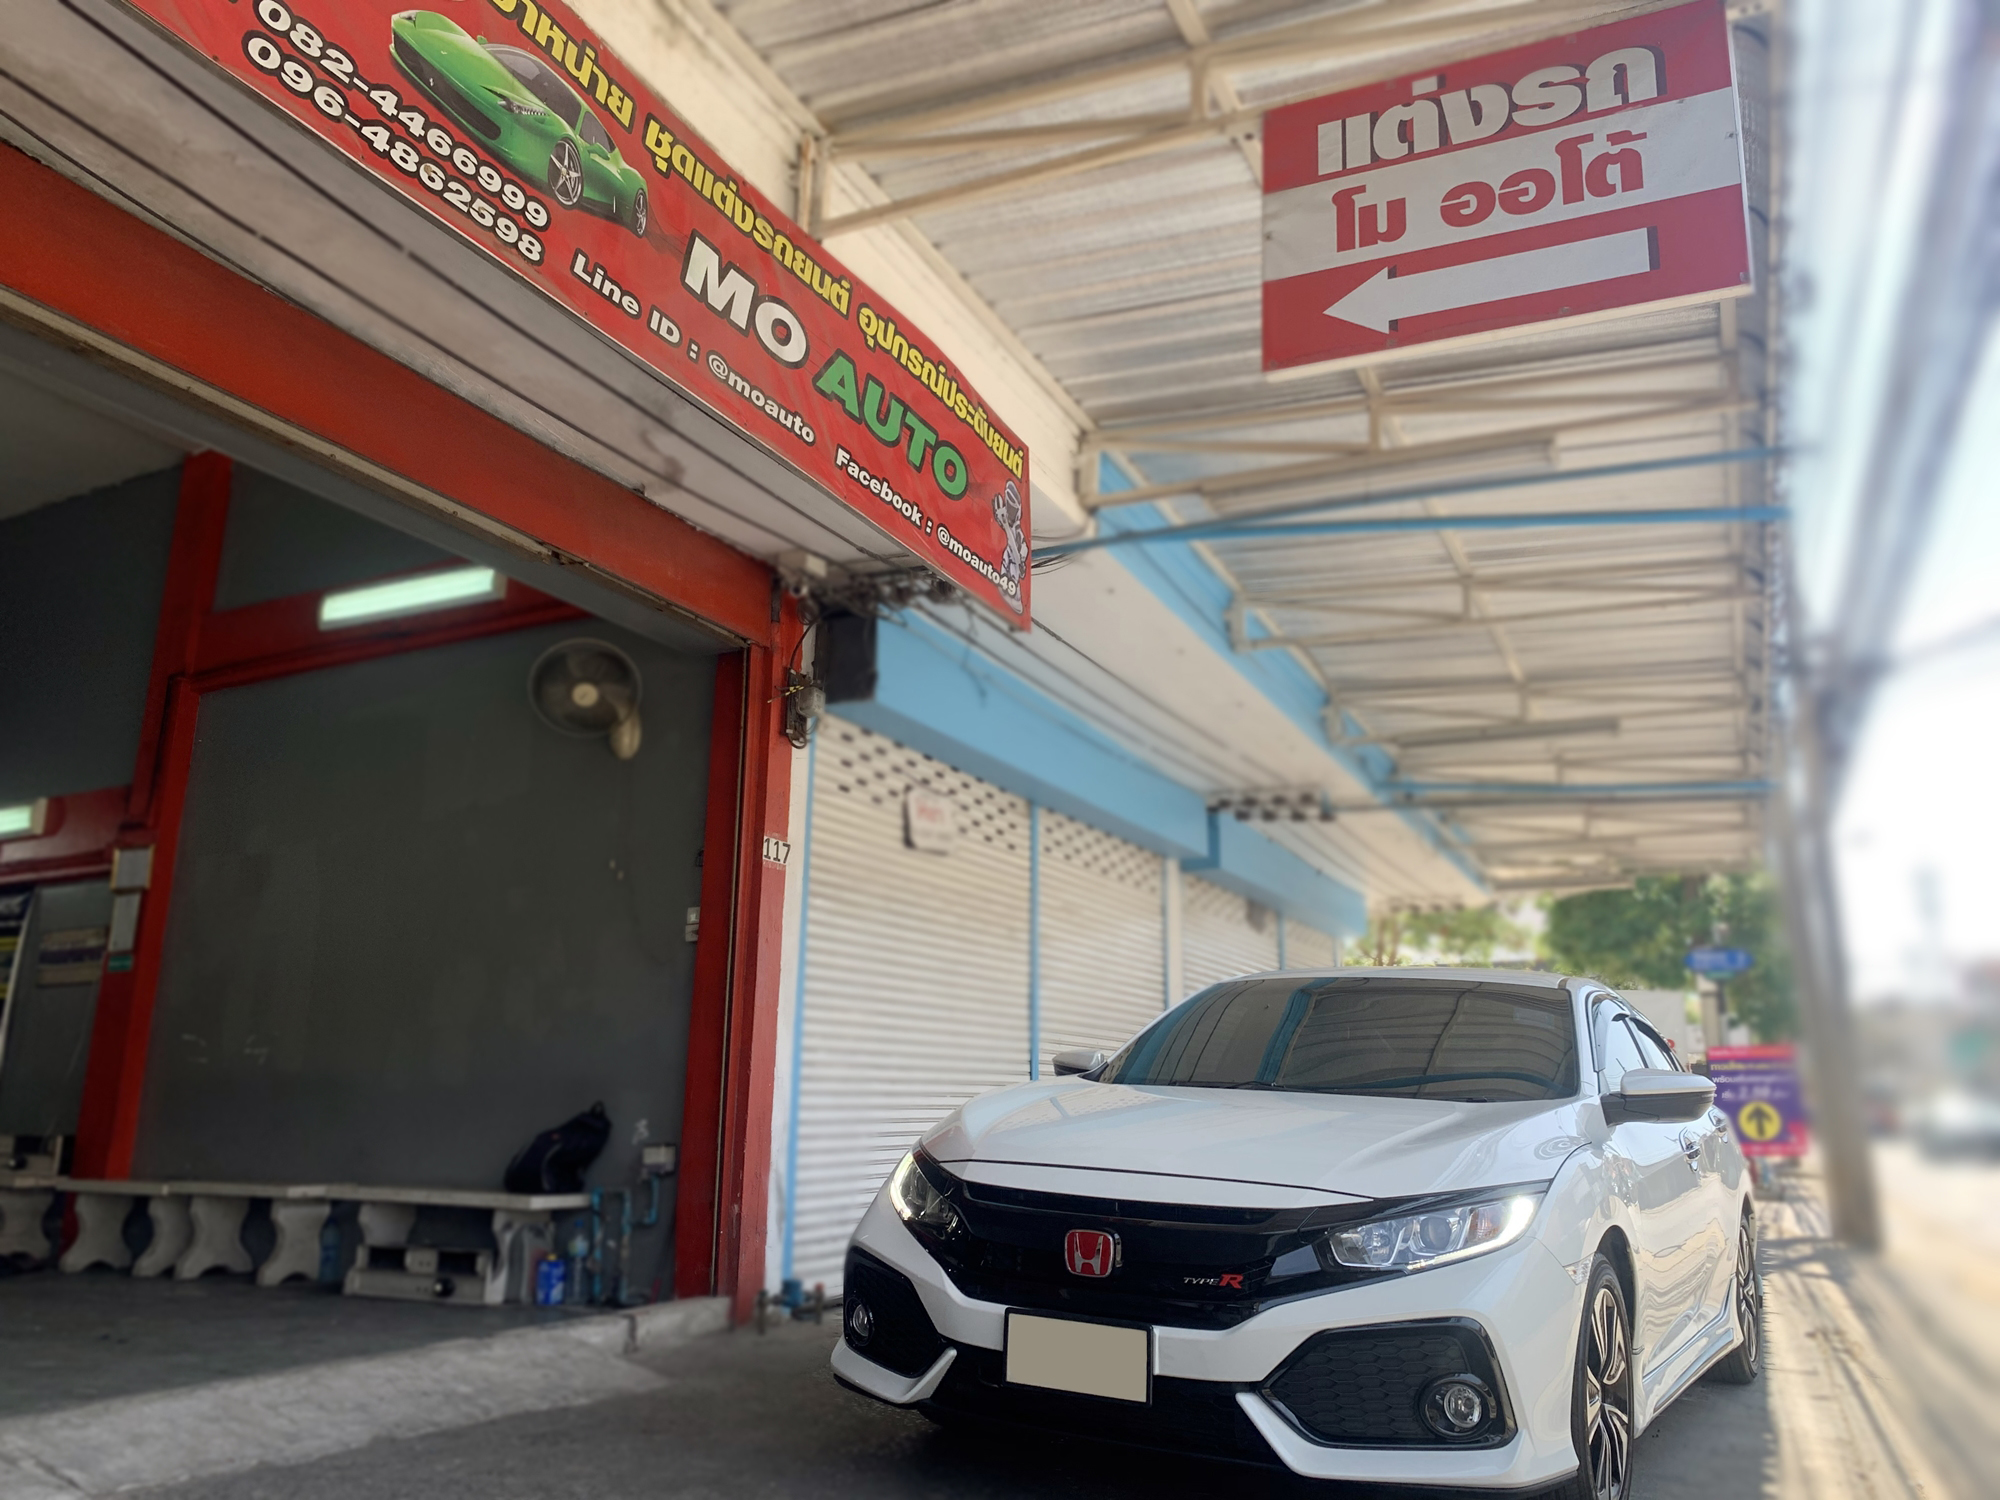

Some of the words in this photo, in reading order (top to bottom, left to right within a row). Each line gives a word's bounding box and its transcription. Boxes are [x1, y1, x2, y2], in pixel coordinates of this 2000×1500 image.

[247, 37, 542, 261] 096-4862598
[258, 0, 548, 228] 082-4466999
[1317, 47, 1660, 176] แต่งรถ
[1332, 185, 1407, 253] โม
[645, 119, 850, 316] ชุดแต่งรถยนต์
[859, 307, 1024, 479] อุปกรณ์ประดับยนต์
[684, 236, 808, 365] MO
[815, 356, 968, 498] AUTO
[573, 253, 640, 317] Line
[650, 309, 681, 344] ID
[709, 354, 815, 443] @moauto
[835, 449, 923, 525] Facebook
[937, 527, 1017, 597] @moauto49
[764, 838, 791, 864] 117
[1184, 1277, 1220, 1286] TYPE
[1219, 1273, 1244, 1289] R
